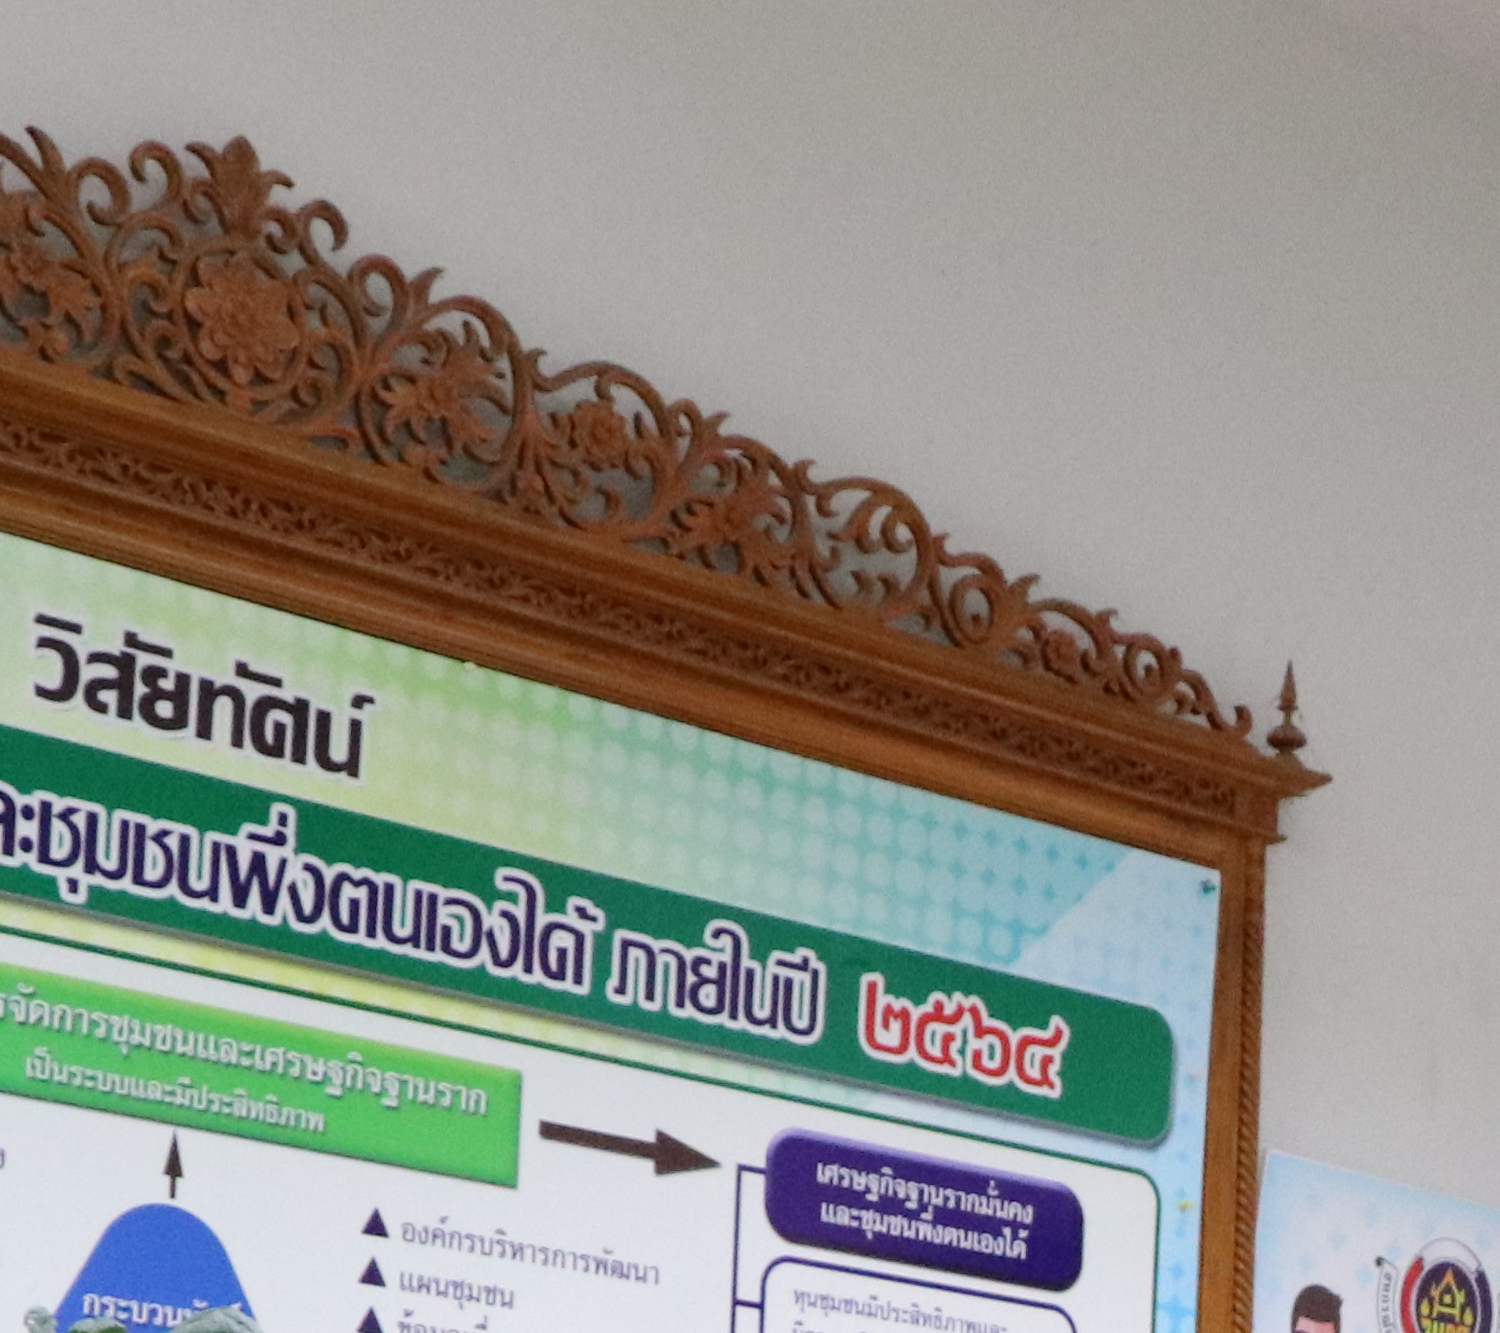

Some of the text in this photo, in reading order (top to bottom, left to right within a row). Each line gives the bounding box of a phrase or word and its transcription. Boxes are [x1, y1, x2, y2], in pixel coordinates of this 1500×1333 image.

[33, 613, 374, 778] วิสัยทัศน์
[613, 926, 823, 1036] ภายในปี
[862, 978, 1067, 1094] ๒๕๖๔
[24, 1050, 327, 1134] เป็นระบบและมีประสิทธิภาพ
[817, 1159, 1034, 1225] เศรษฐกิจฐานรากมั่นคง
[400, 1216, 661, 1286] องค์กรบริหารการพัฒนา
[821, 1204, 1027, 1260] และชุมชนพึ่งตนเองได้
[399, 1270, 514, 1310] แผนชุมชน
